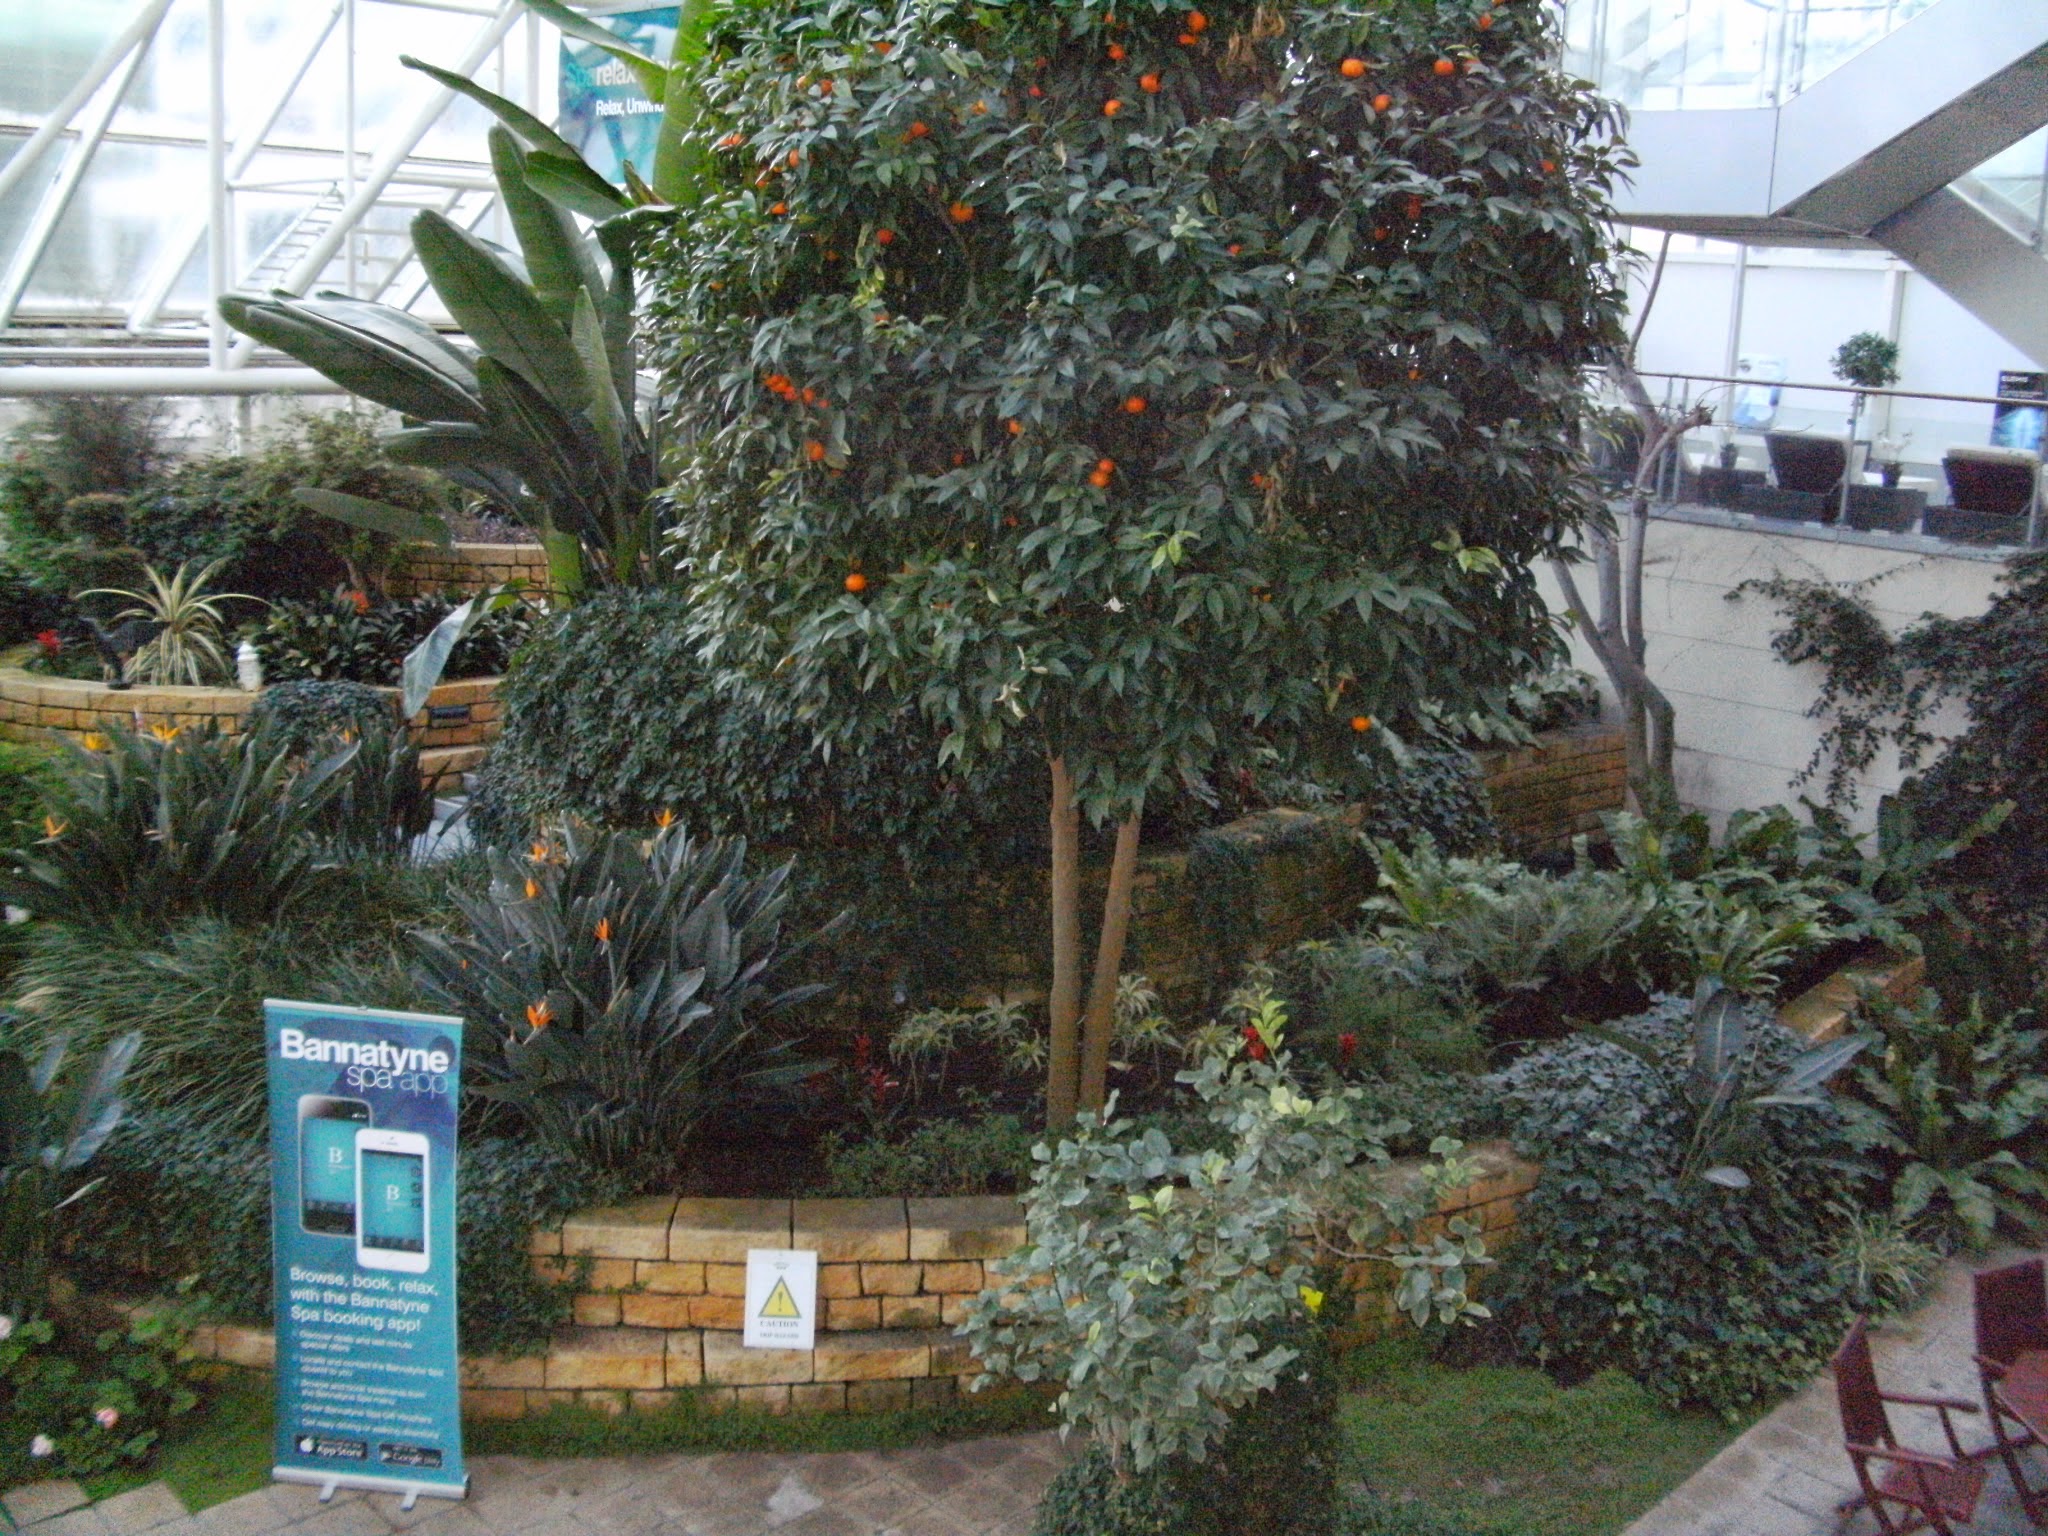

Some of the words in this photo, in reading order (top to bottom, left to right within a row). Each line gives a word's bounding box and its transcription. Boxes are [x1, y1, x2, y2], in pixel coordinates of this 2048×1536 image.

[596, 100, 625, 116] Relax,
[280, 1028, 449, 1074] Bannatyne
[347, 1066, 392, 1092] spa
[400, 1071, 448, 1098] app
[290, 1266, 348, 1287] Browse,
[291, 1289, 319, 1302] with
[323, 1291, 347, 1305] the
[351, 1293, 430, 1314] Bannatyne
[291, 1305, 320, 1322] Spa
[323, 1310, 384, 1331] booking
[387, 1318, 421, 1334] app!
